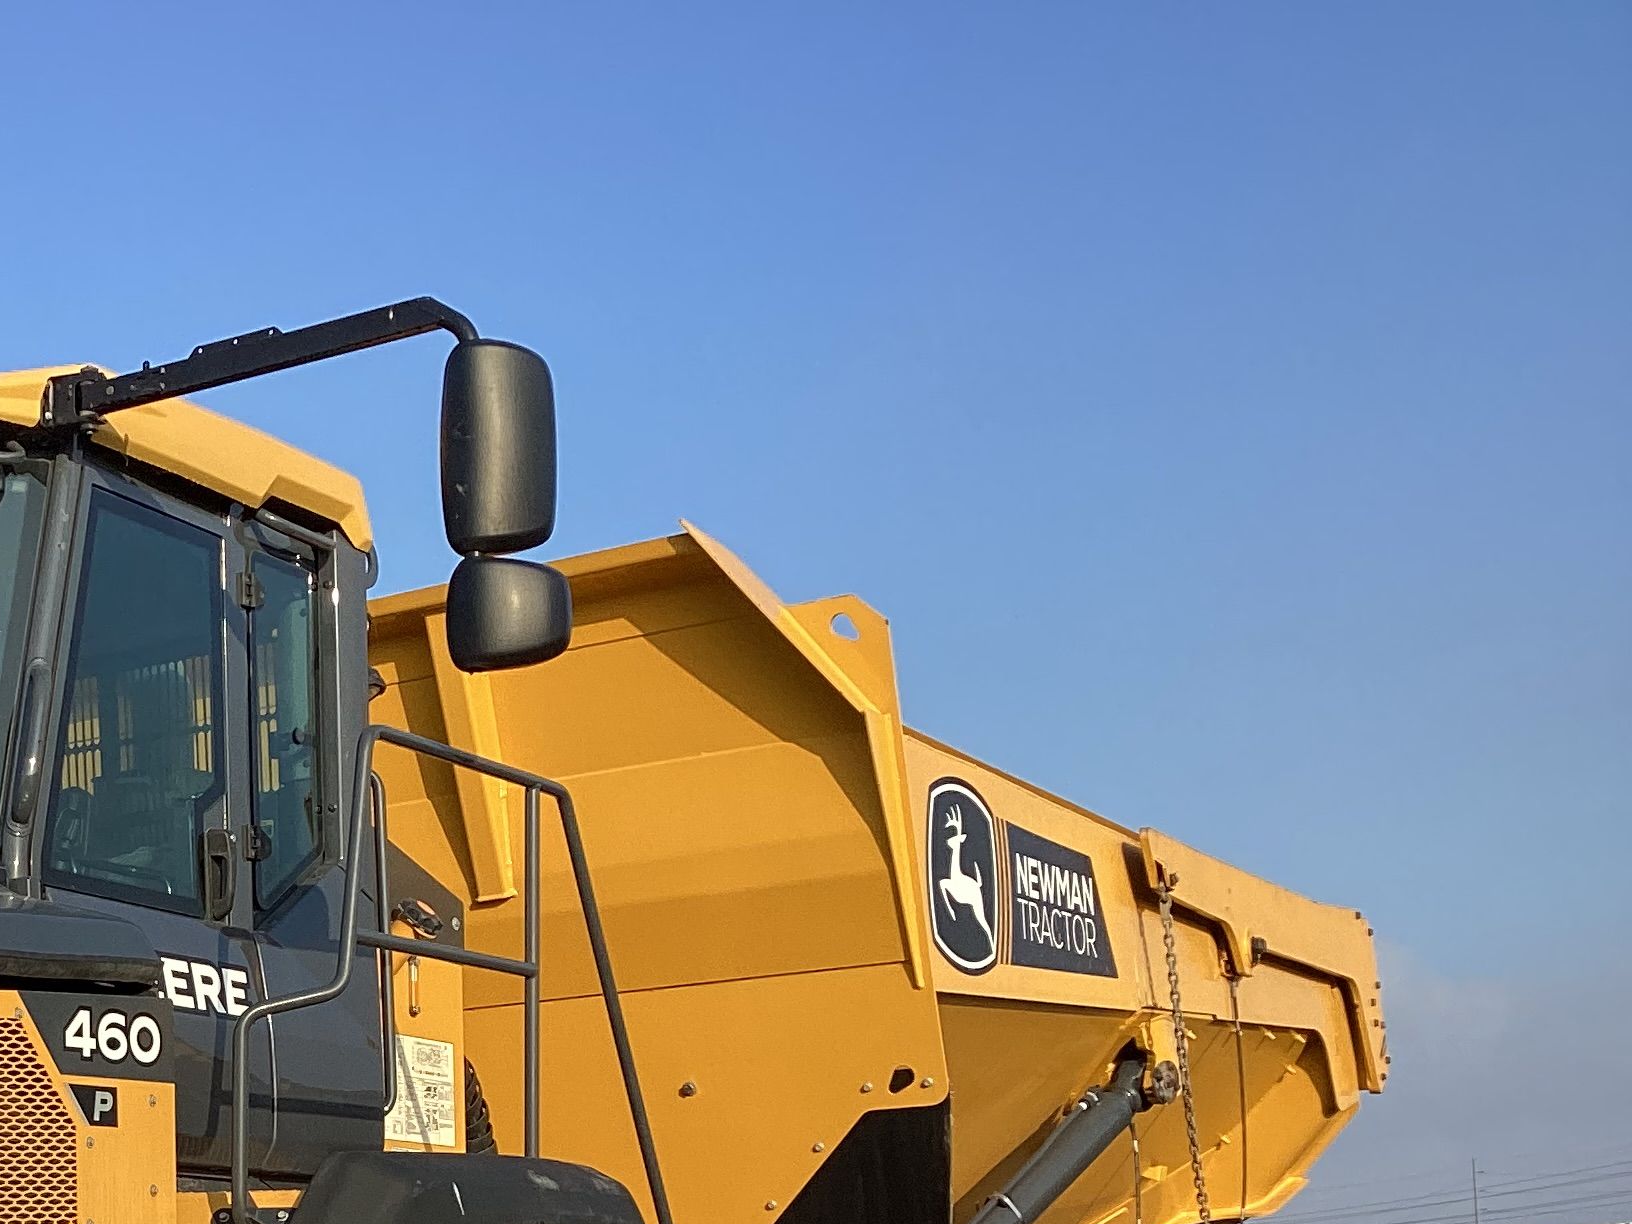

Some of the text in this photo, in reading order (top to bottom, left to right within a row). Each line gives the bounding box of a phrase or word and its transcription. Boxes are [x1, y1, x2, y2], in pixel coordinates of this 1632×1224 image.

[1015, 852, 1095, 917] NEWMAN
[1016, 897, 1098, 959] TRACTOR
[156, 956, 250, 1017] ERE
[65, 1009, 162, 1064] 460
[92, 1090, 114, 1122] P
